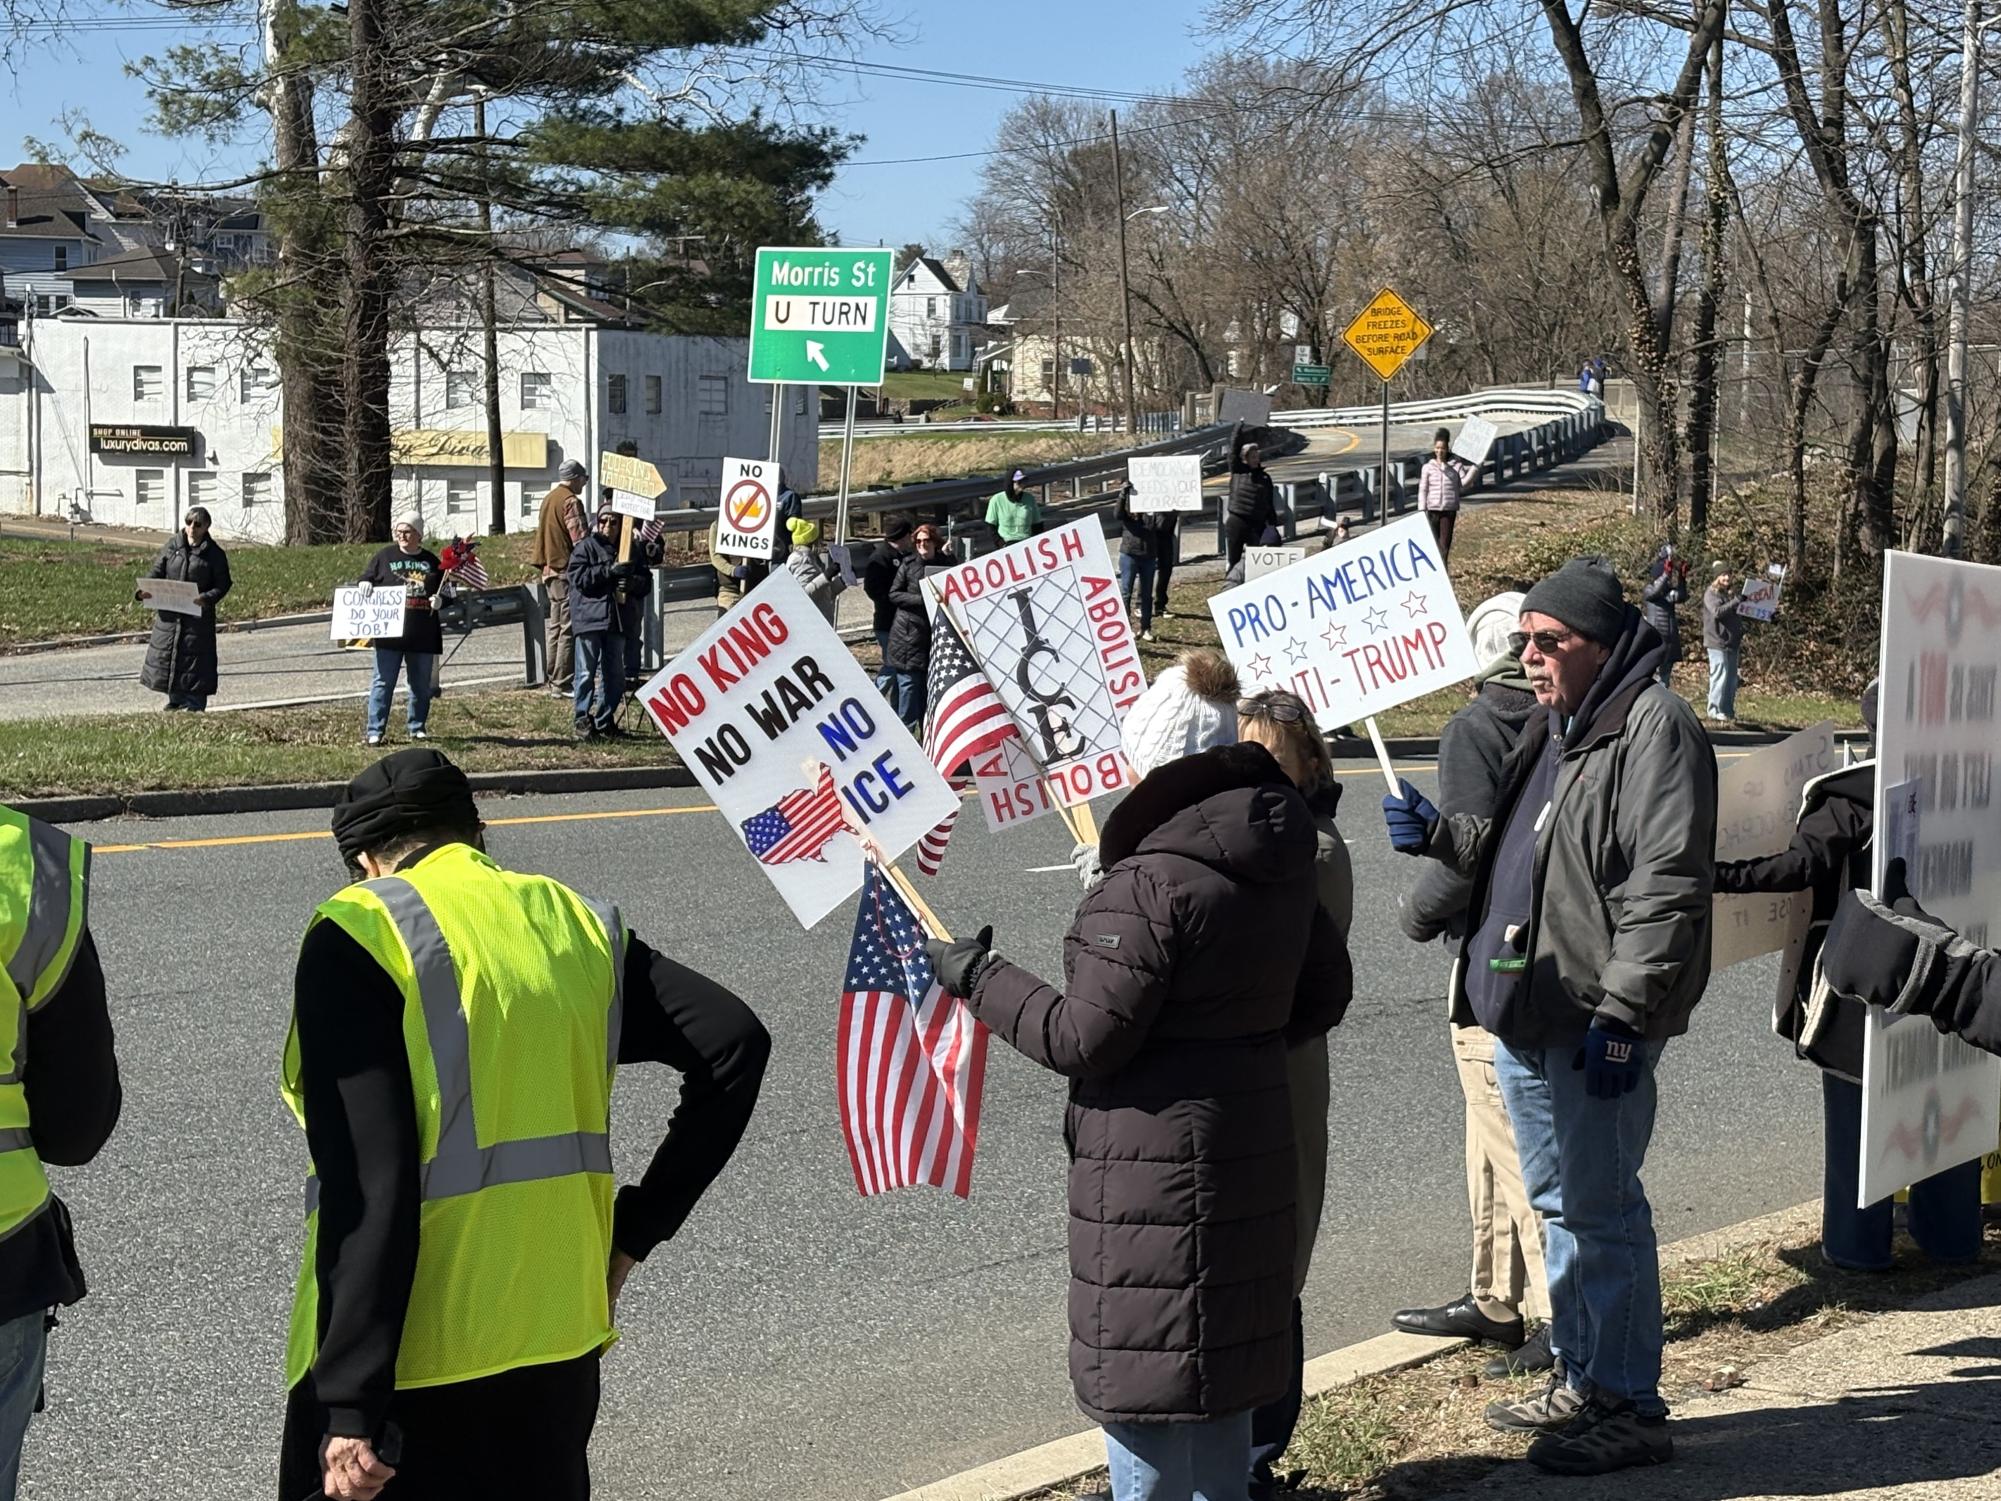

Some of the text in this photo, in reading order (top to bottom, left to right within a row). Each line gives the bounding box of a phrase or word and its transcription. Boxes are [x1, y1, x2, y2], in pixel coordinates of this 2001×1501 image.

[771, 260, 876, 287] Morris St
[775, 301, 868, 326] U TURN
[1371, 307, 1402, 317] BRIDGE
[1367, 320, 1407, 330] FREEZES
[1355, 332, 1418, 344] BEFORE ROAD
[1367, 346, 1407, 356] SURFACE
[93, 428, 142, 438] SHOP ONLINE
[100, 438, 188, 453] luxurydivas.com
[740, 464, 763, 478] NO
[720, 533, 769, 550] KINGS
[943, 528, 1085, 607] ABOLISH
[1251, 552, 1297, 566] VOTE
[351, 608, 400, 622] DO YOUR
[350, 621, 389, 636] JOB!
[648, 602, 790, 736] NO KING
[1264, 621, 1447, 713] TI-TRUMP
[1007, 586, 1085, 766] ICE
[694, 655, 836, 786] NO WAR
[816, 697, 877, 762] NO
[841, 749, 915, 825] ICE
[990, 753, 1129, 823] BOLISH
